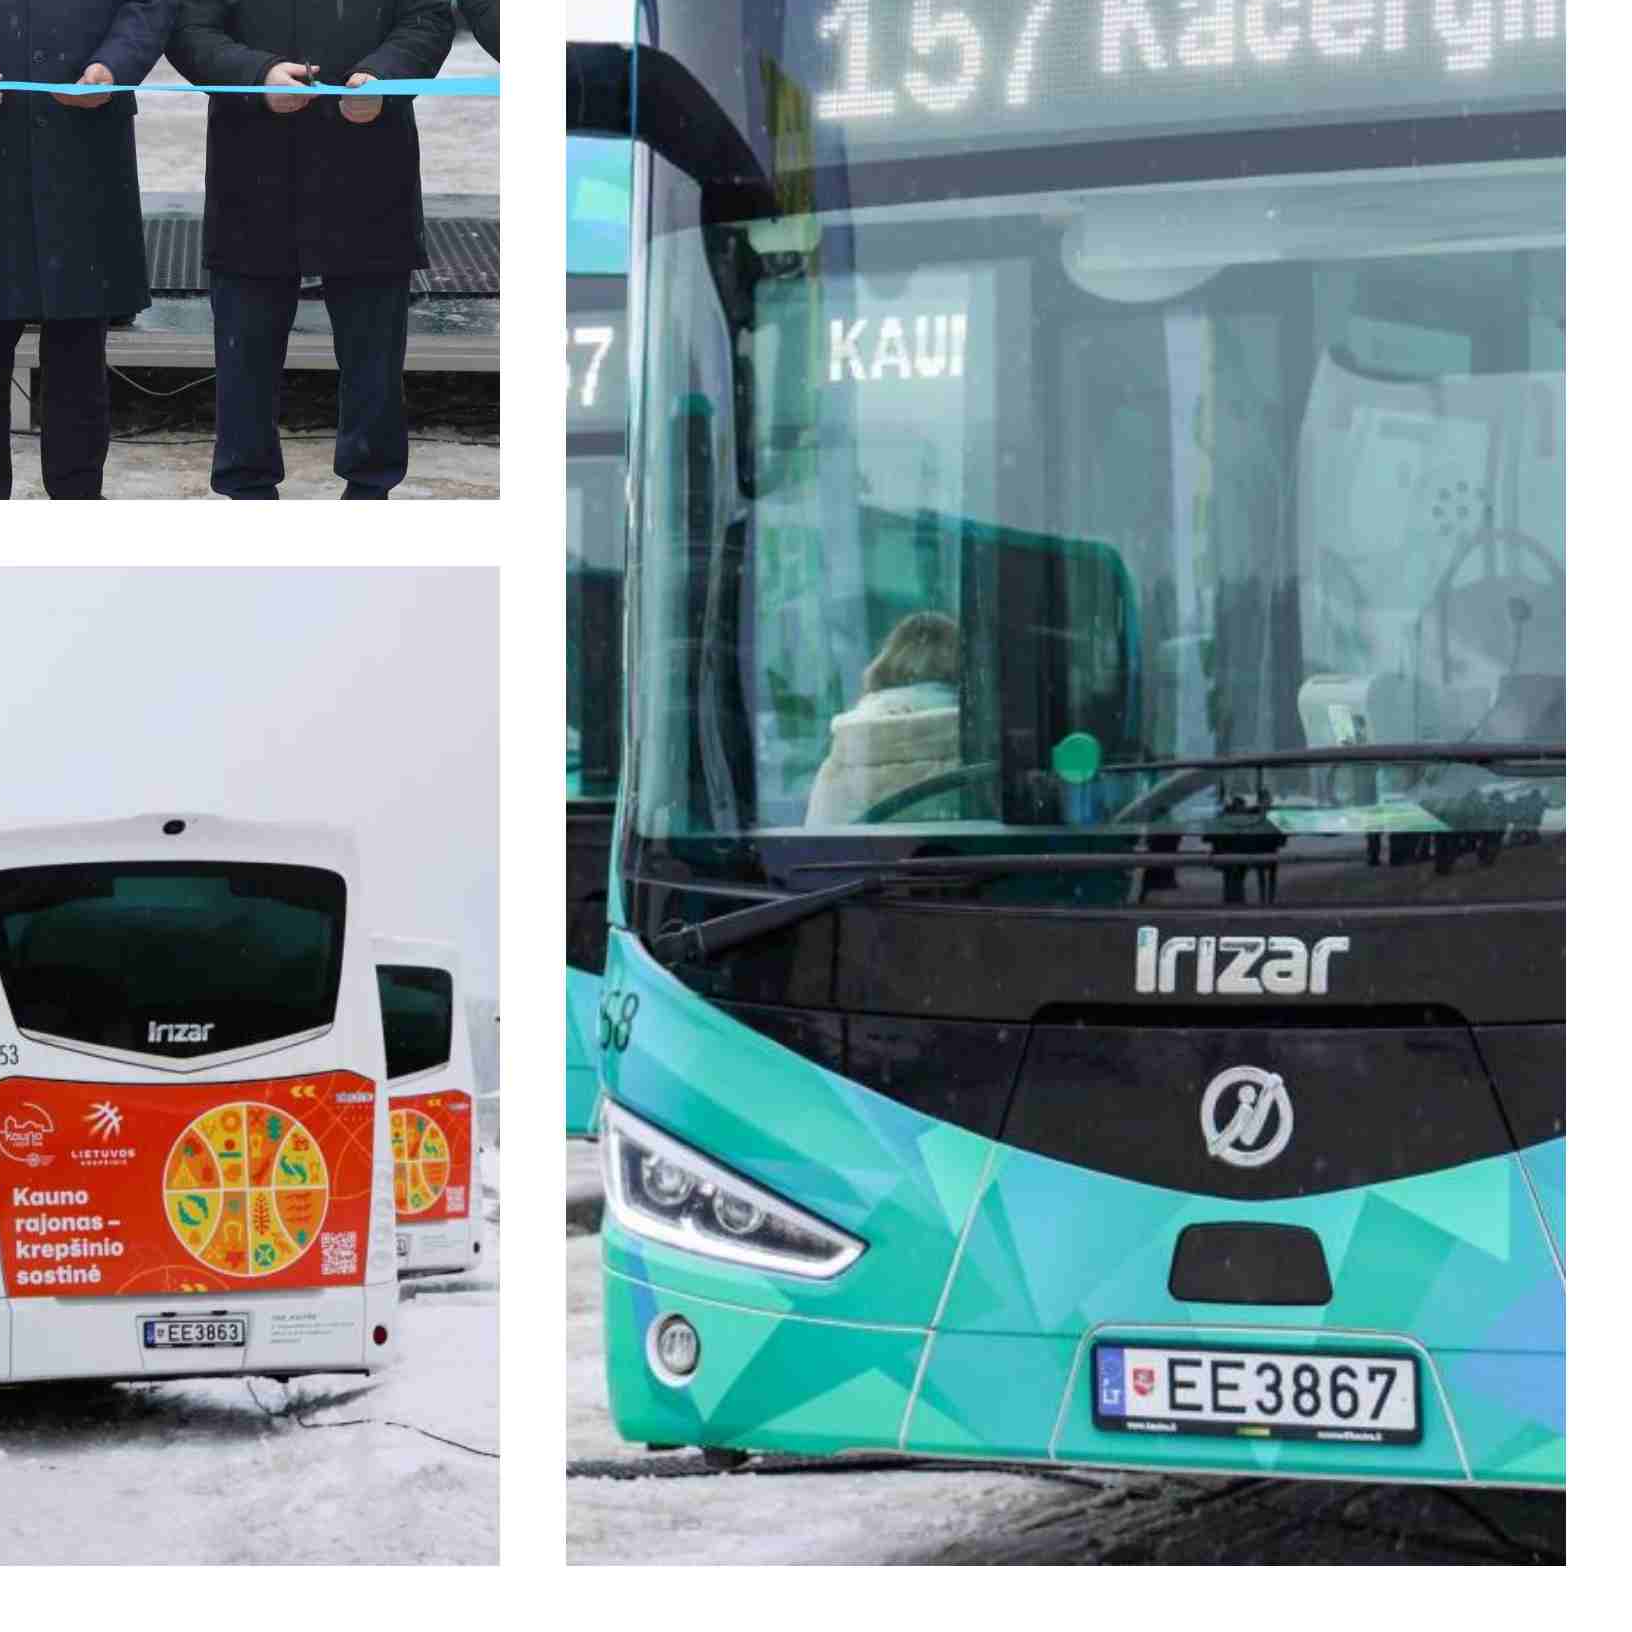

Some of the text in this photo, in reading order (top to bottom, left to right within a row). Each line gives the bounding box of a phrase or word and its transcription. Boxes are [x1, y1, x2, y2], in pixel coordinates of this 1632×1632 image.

[1135, 925, 1351, 995] Irizar
[147, 1020, 215, 1043] Irizar
[70, 1148, 137, 1159] LIETUVOS
[12, 1186, 89, 1207] Kauno
[15, 1212, 104, 1236] rajonas
[15, 1236, 125, 1261] krepšinio
[15, 1263, 102, 1286] sostinė
[167, 1323, 239, 1342] EE3863
[1167, 1356, 1398, 1421] EE3867
